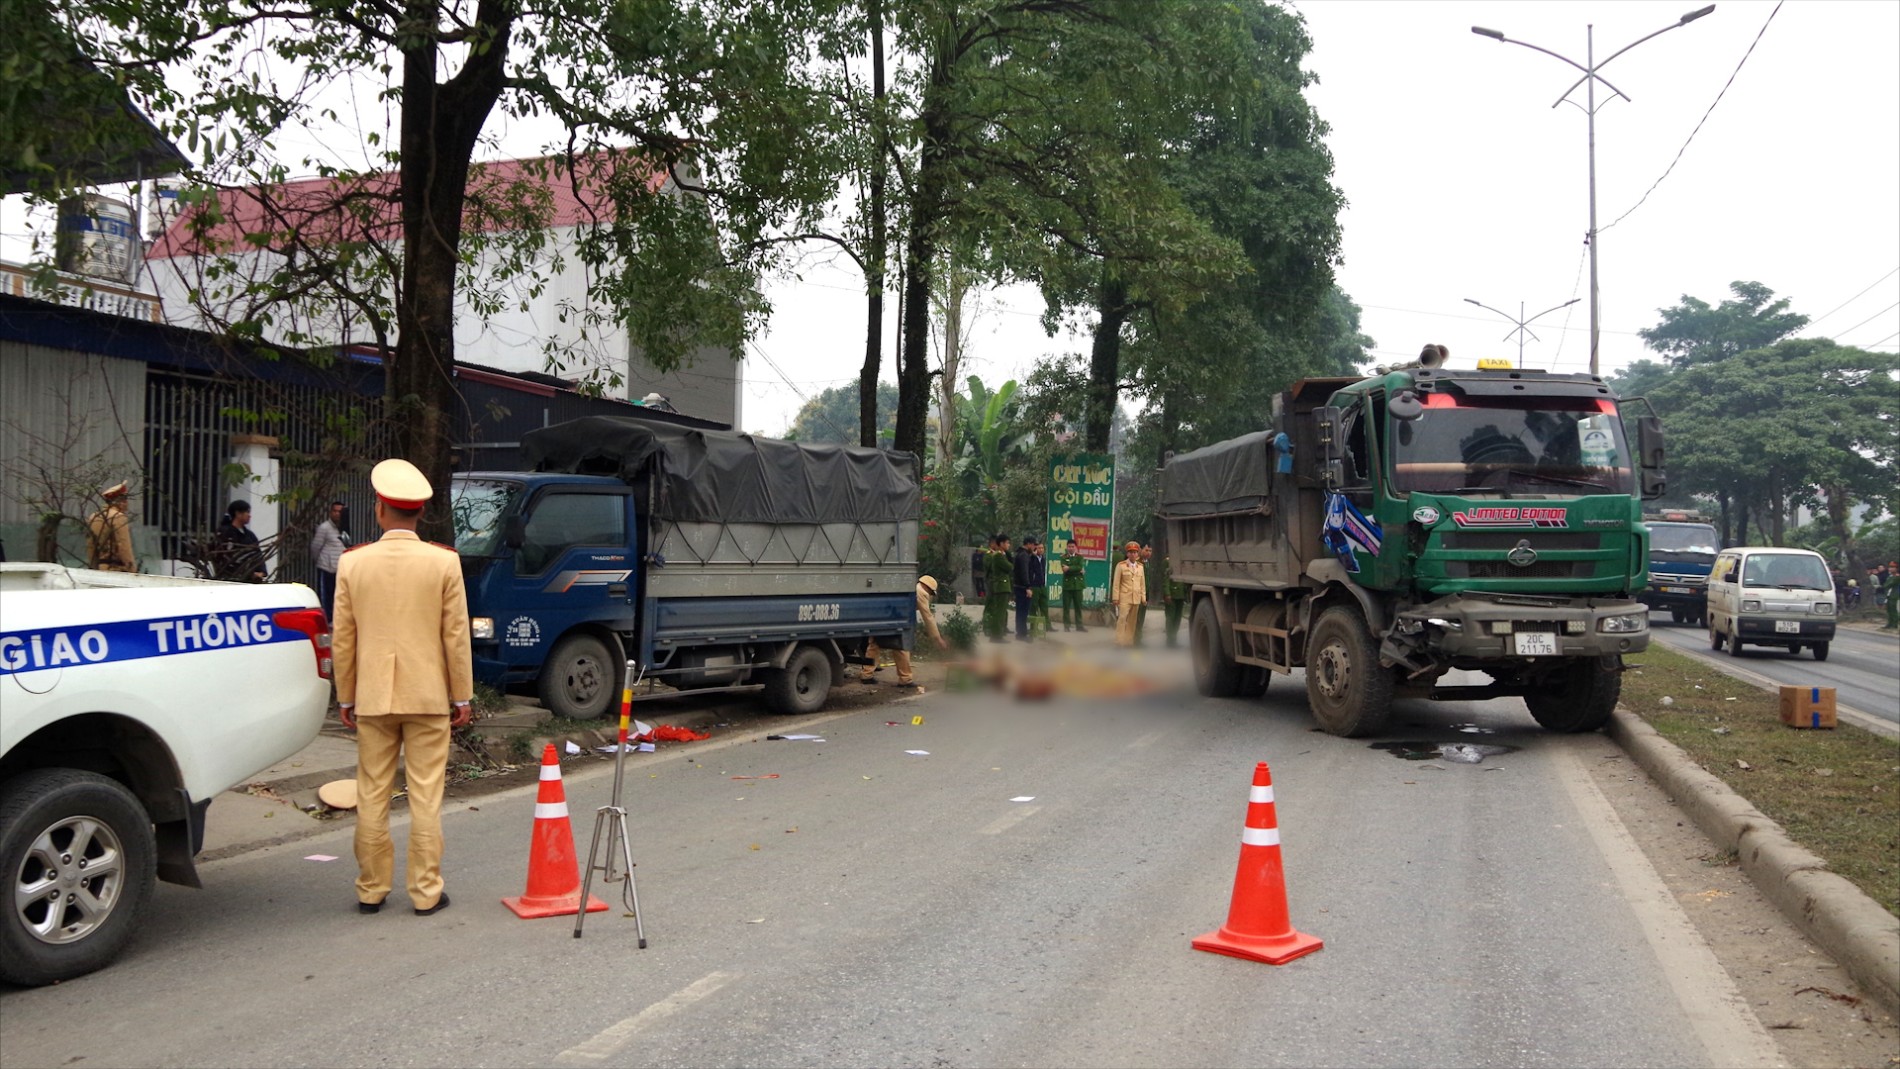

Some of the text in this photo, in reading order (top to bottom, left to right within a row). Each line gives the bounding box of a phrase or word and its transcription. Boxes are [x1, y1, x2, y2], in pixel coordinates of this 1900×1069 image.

[1083, 487, 1110, 506] ĐẦU
[1467, 507, 1567, 520] LIMITED EDITION
[798, 603, 840, 621] 89C-088.36
[0, 613, 273, 672] GIAO THÔNG
[1526, 634, 1544, 644] 20C
[1520, 644, 1552, 653] 211.76
